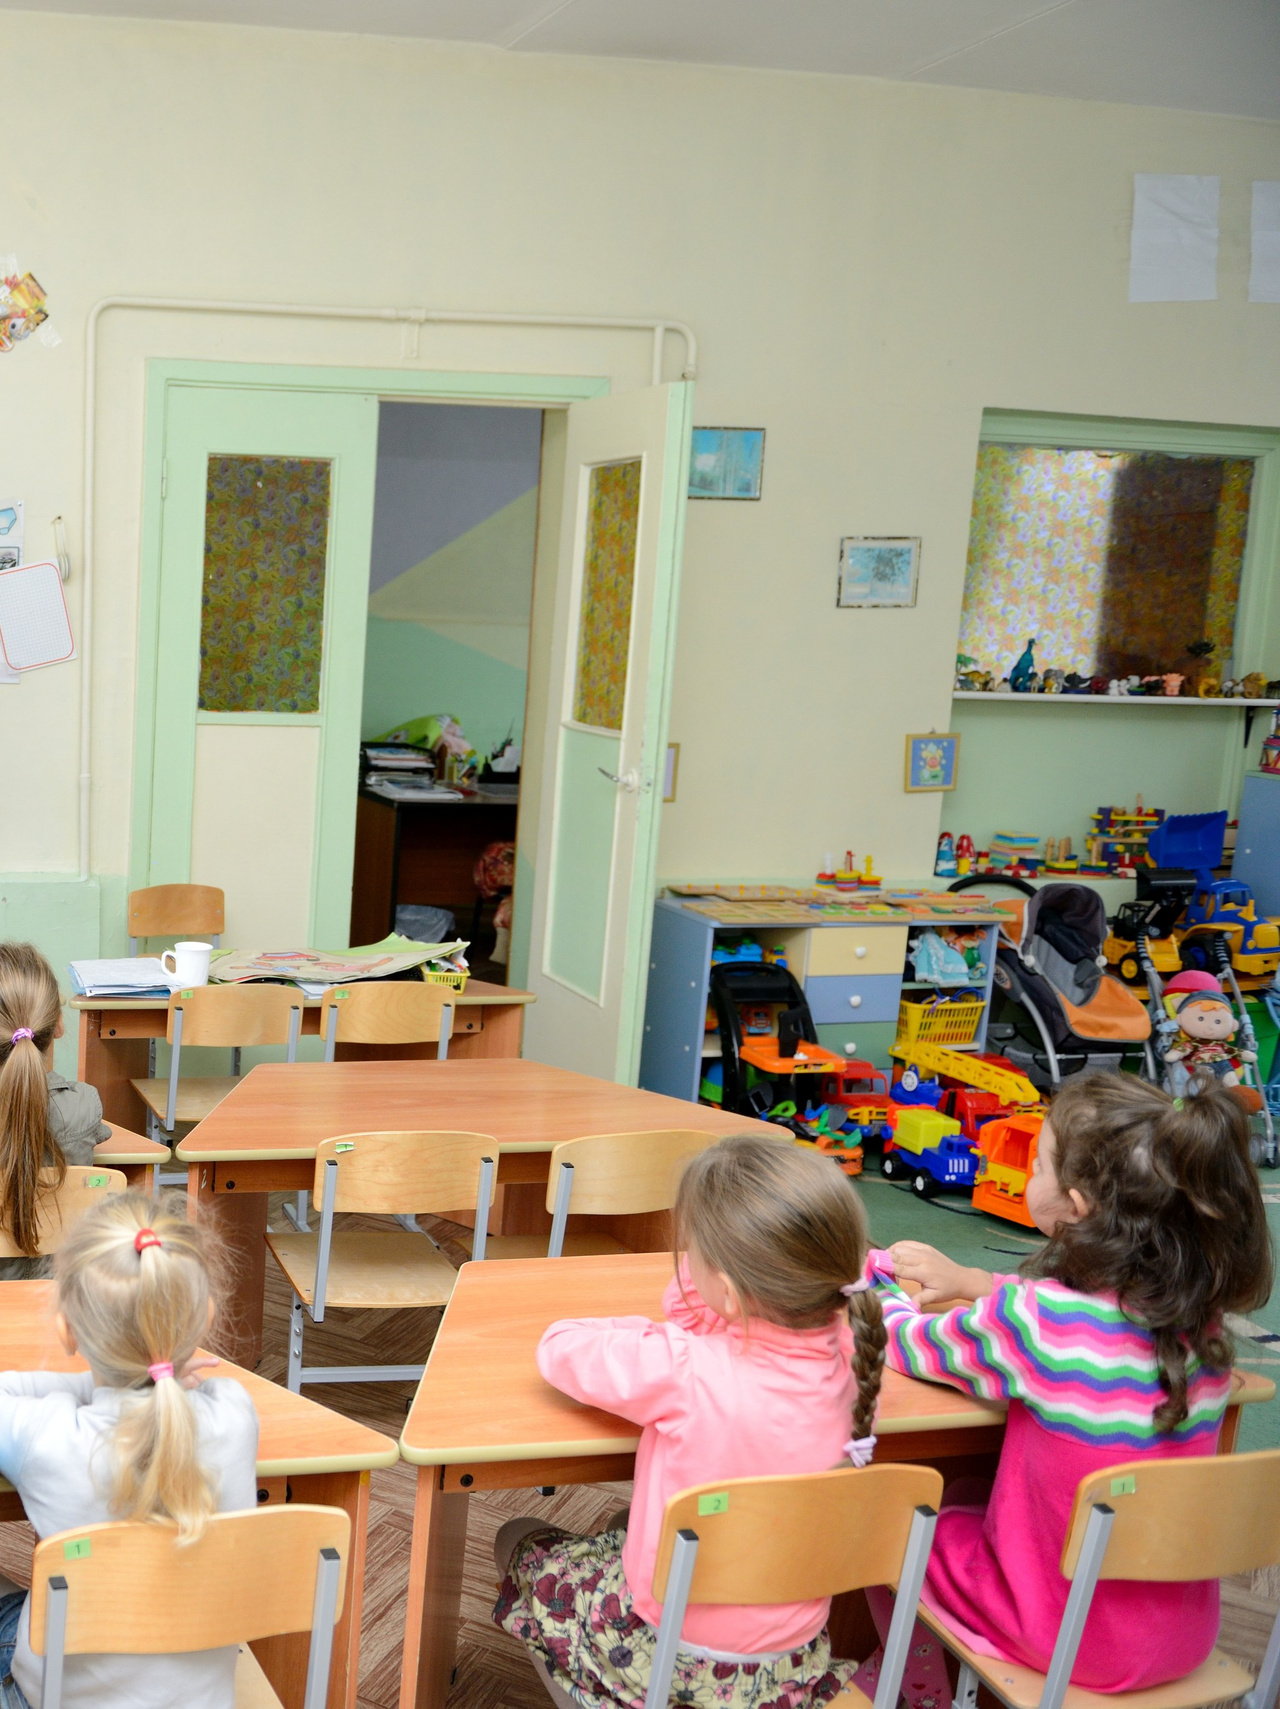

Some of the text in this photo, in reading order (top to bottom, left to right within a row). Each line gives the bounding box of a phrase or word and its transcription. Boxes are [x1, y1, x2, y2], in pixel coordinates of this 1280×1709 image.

[95, 1179, 101, 1187] 2
[713, 1499, 721, 1510] 2
[75, 1544, 80, 1555] 1
